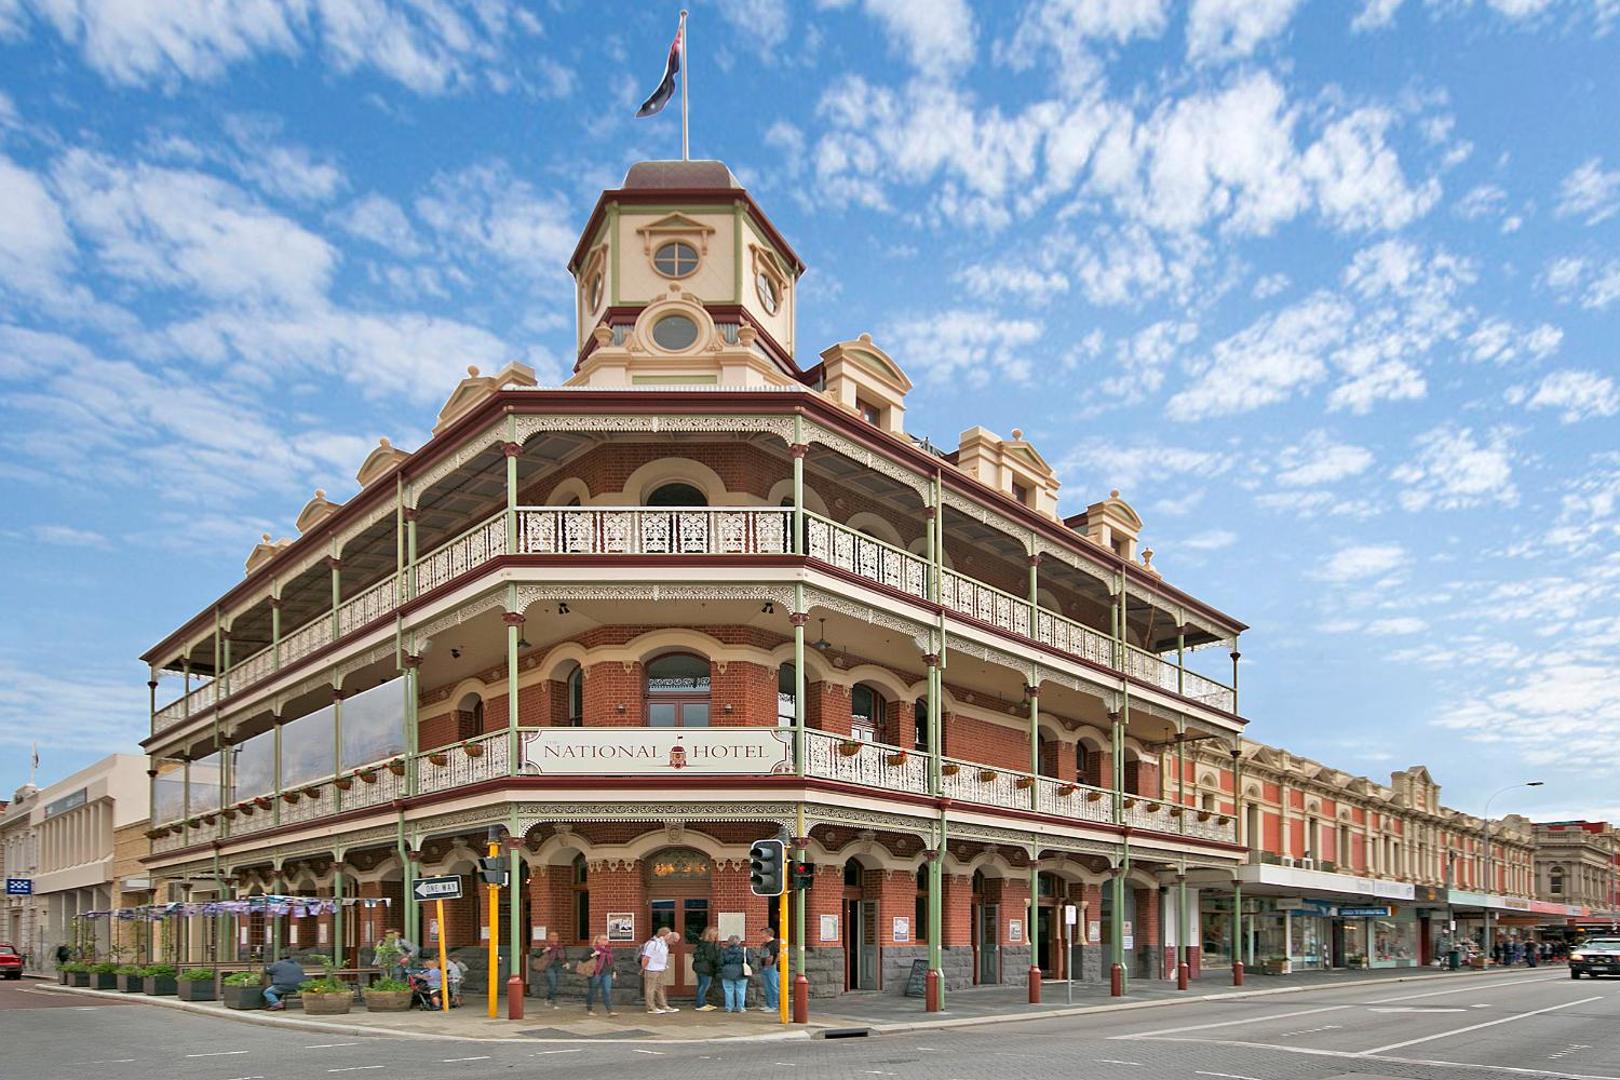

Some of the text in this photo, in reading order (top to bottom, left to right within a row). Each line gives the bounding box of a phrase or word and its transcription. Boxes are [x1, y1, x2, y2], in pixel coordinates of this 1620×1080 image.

[544, 745, 770, 758] NATIONAL HOTEL
[426, 883, 455, 893] ONE WAY
